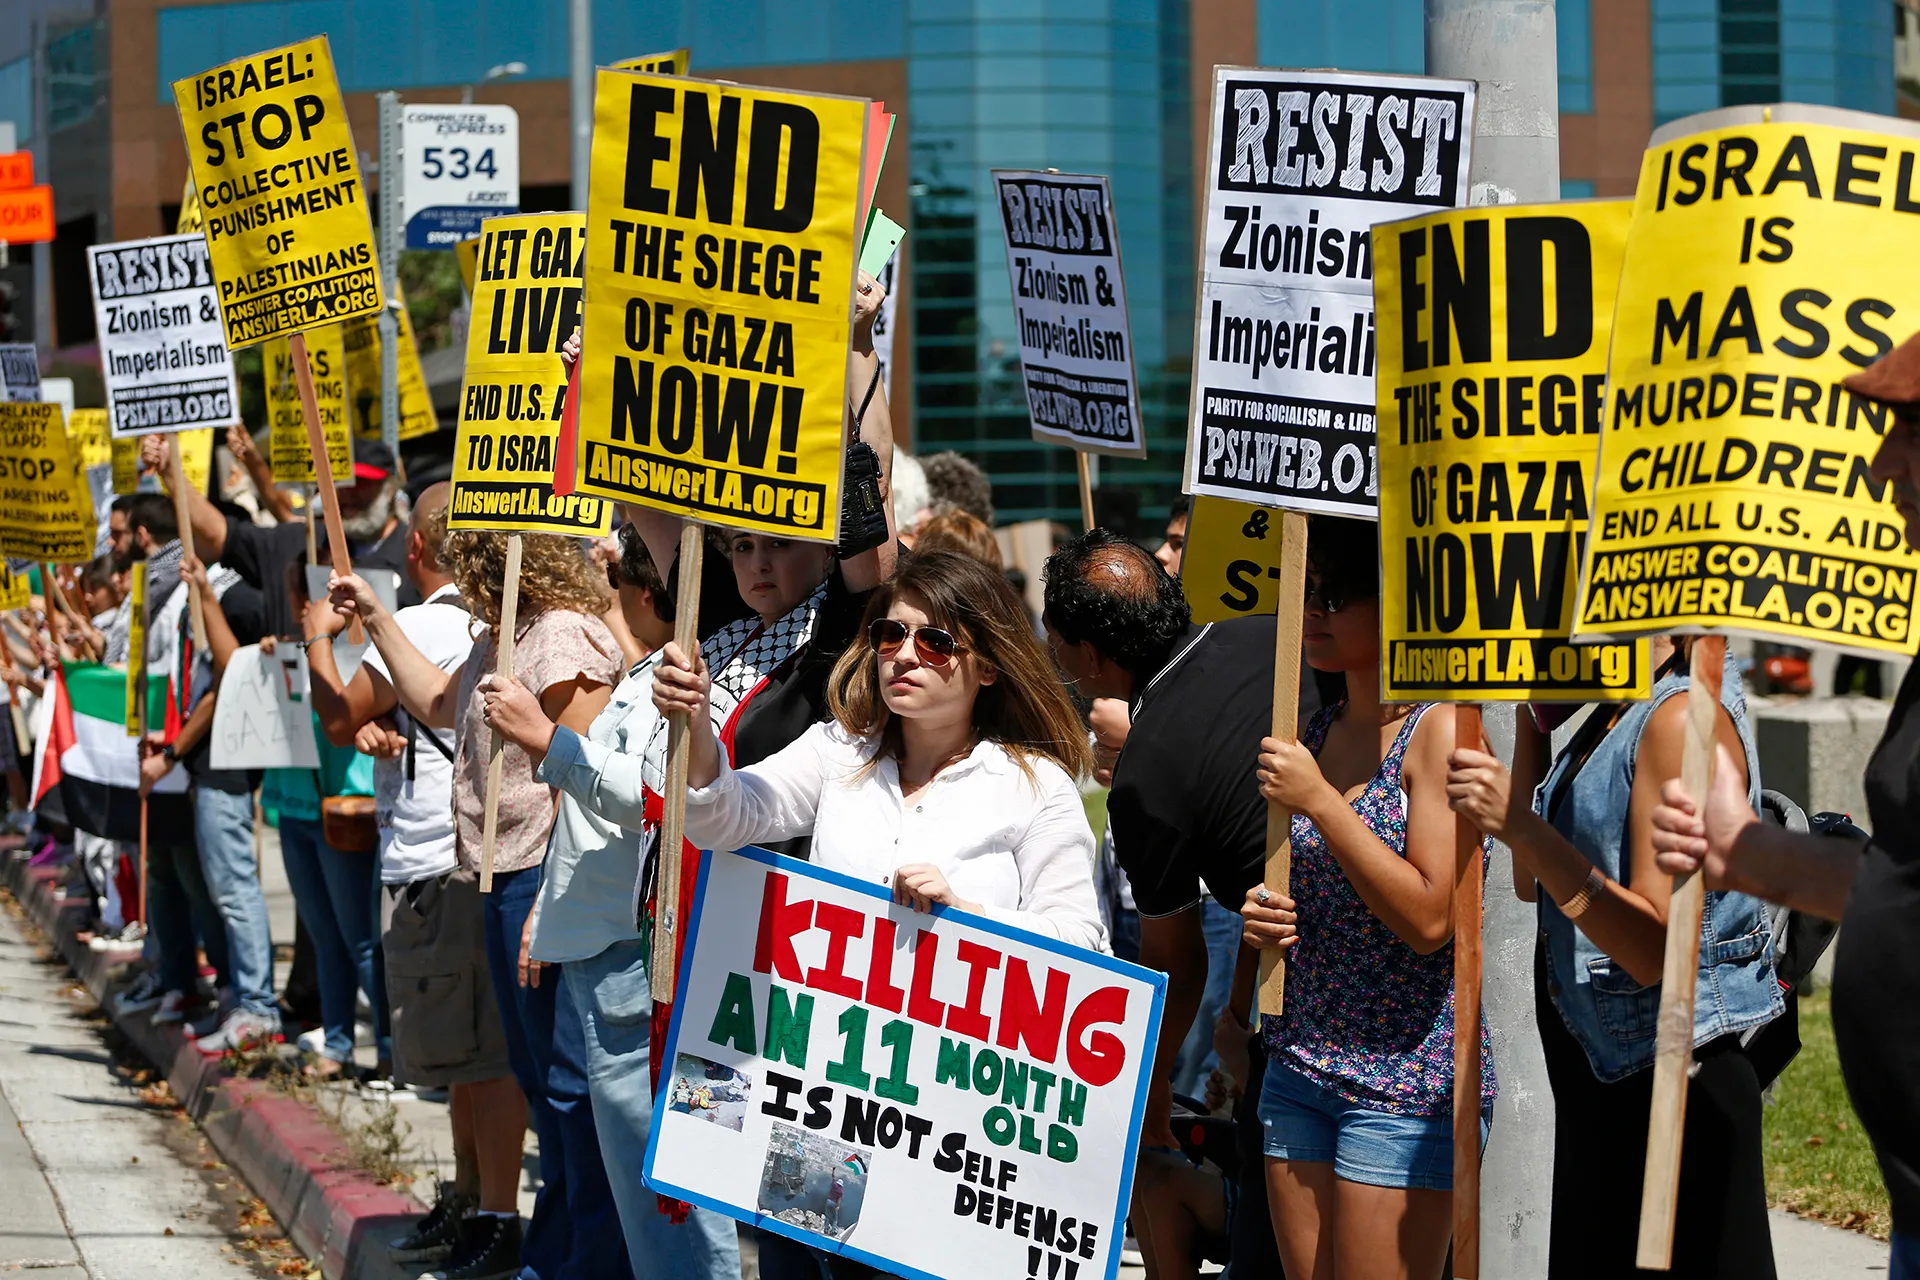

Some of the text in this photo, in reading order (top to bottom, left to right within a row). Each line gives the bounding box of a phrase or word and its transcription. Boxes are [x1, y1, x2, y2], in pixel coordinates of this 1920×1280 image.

[197, 52, 313, 111] ISRAEL:
[202, 94, 325, 167] STOP
[624, 83, 820, 233] END
[1228, 88, 1456, 197] RESIST
[203, 147, 350, 208] COLLECTIVE
[422, 147, 498, 179] 534
[209, 179, 356, 241] PUNISHMENT
[1003, 184, 1104, 251] RESIST
[98, 242, 210, 298] RESIST
[266, 229, 296, 255] OF
[480, 228, 527, 282] LET
[610, 219, 822, 304] THE SIEGE
[1740, 217, 1795, 264] IS
[221, 242, 371, 301] PALESTINIANS
[228, 270, 374, 322] ANSWER COALITION
[1015, 257, 1116, 307] Zionism &
[1399, 217, 1592, 372] END
[106, 294, 217, 335] Zionism &
[230, 287, 378, 346] ANSWERLA.ORG
[624, 297, 795, 378] OF GAZA
[1020, 307, 1126, 362] Imperialism
[1209, 300, 1375, 380] Imperiali
[1652, 286, 1895, 368] MASS
[109, 338, 225, 380] Imperialism
[117, 392, 230, 430] PSLWEB.ORG
[464, 385, 501, 421] END
[506, 384, 545, 421] U.S.
[611, 356, 804, 475] NOW!
[1029, 387, 1129, 437] PSLWEB.ORG
[1206, 396, 1375, 433] PARTY FOR SOCIALISM & LIB
[1394, 374, 1606, 446] THE SIEGE
[1614, 373, 1891, 436] MURDERIN
[467, 434, 558, 473] TO ISRA
[454, 486, 600, 524] AnswerLA.org
[589, 445, 819, 527] AnswerLA.org
[1411, 461, 1588, 528] OF GAZA
[1242, 509, 1270, 540] &
[1602, 509, 1659, 541] END
[1666, 502, 1721, 533] ALL
[1736, 502, 1811, 539] U.S.
[1592, 544, 1912, 602] ANSWER COALITION
[1584, 577, 1909, 642] ANSWERLA.ORG
[1393, 639, 1630, 687] AnswerLA.org
[754, 870, 1130, 1086] KILLING
[708, 971, 1088, 1127] AN 11 MONTH
[761, 1070, 1018, 1192] IS NOT SELF
[982, 1105, 1080, 1165] OLD
[953, 1184, 1099, 1261] DEFENSE
